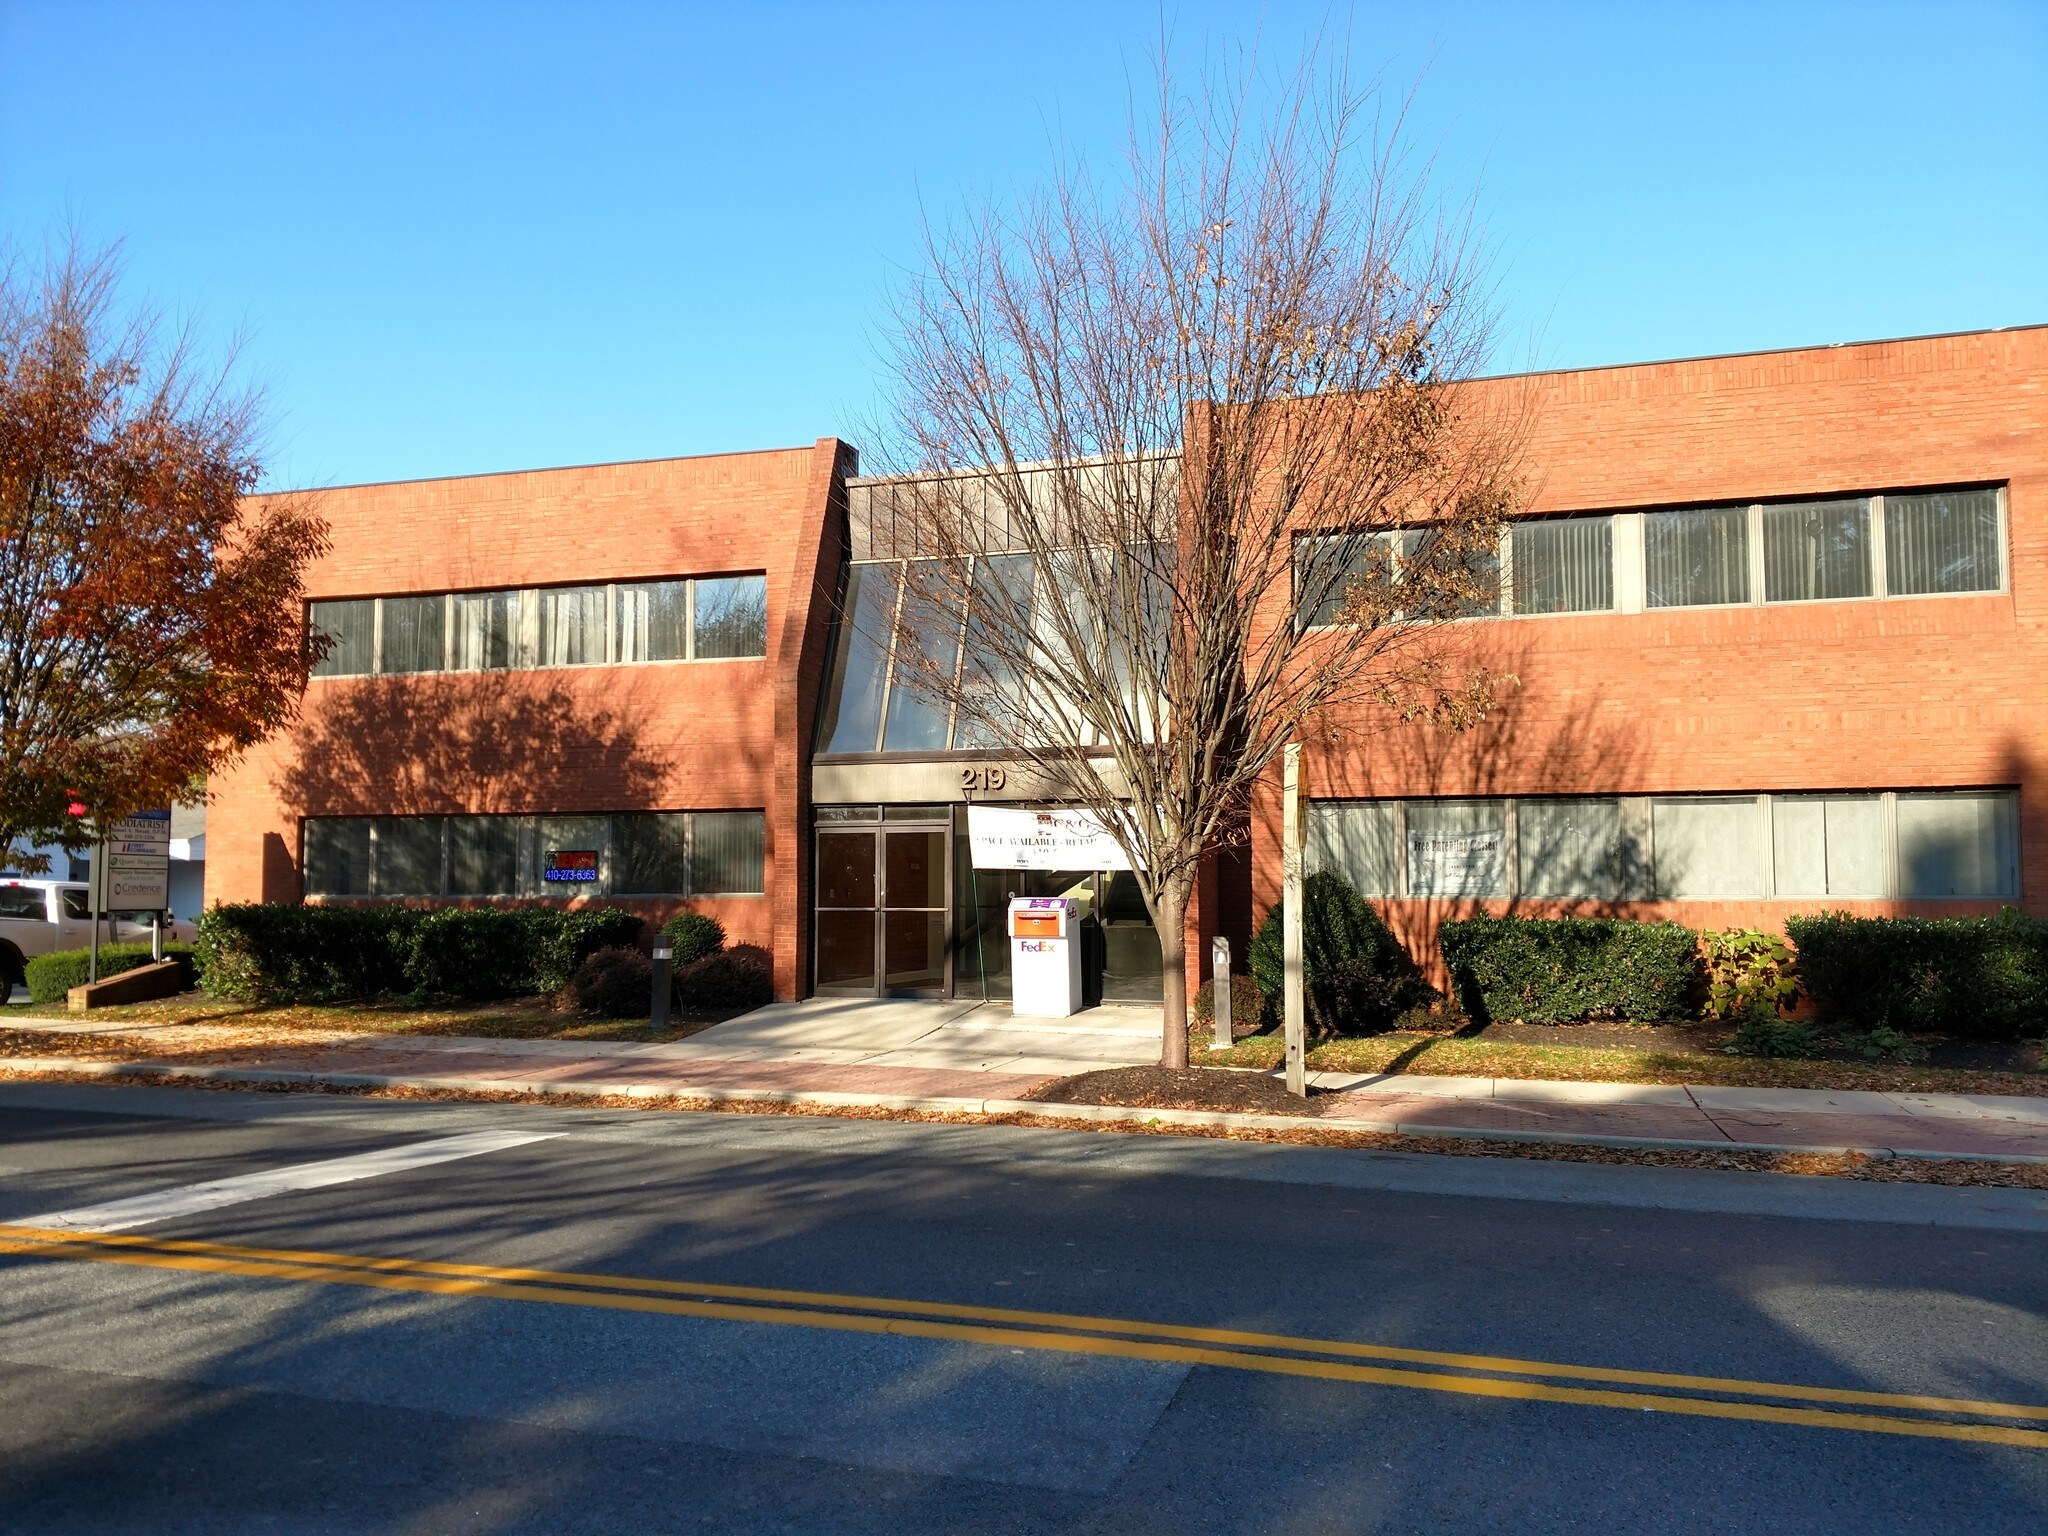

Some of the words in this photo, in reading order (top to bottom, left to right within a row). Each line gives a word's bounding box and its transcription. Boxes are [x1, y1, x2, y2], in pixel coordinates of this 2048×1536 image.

[960, 766, 1006, 790] 219
[1010, 837, 1058, 846] AVAILABLE
[1065, 838, 1097, 846] RETAI
[1414, 840, 1430, 851] Free
[1432, 839, 1469, 852] Parenting
[544, 869, 596, 880] 410-273-6363
[122, 883, 161, 893] Credence
[1021, 941, 1055, 952] FedEx
